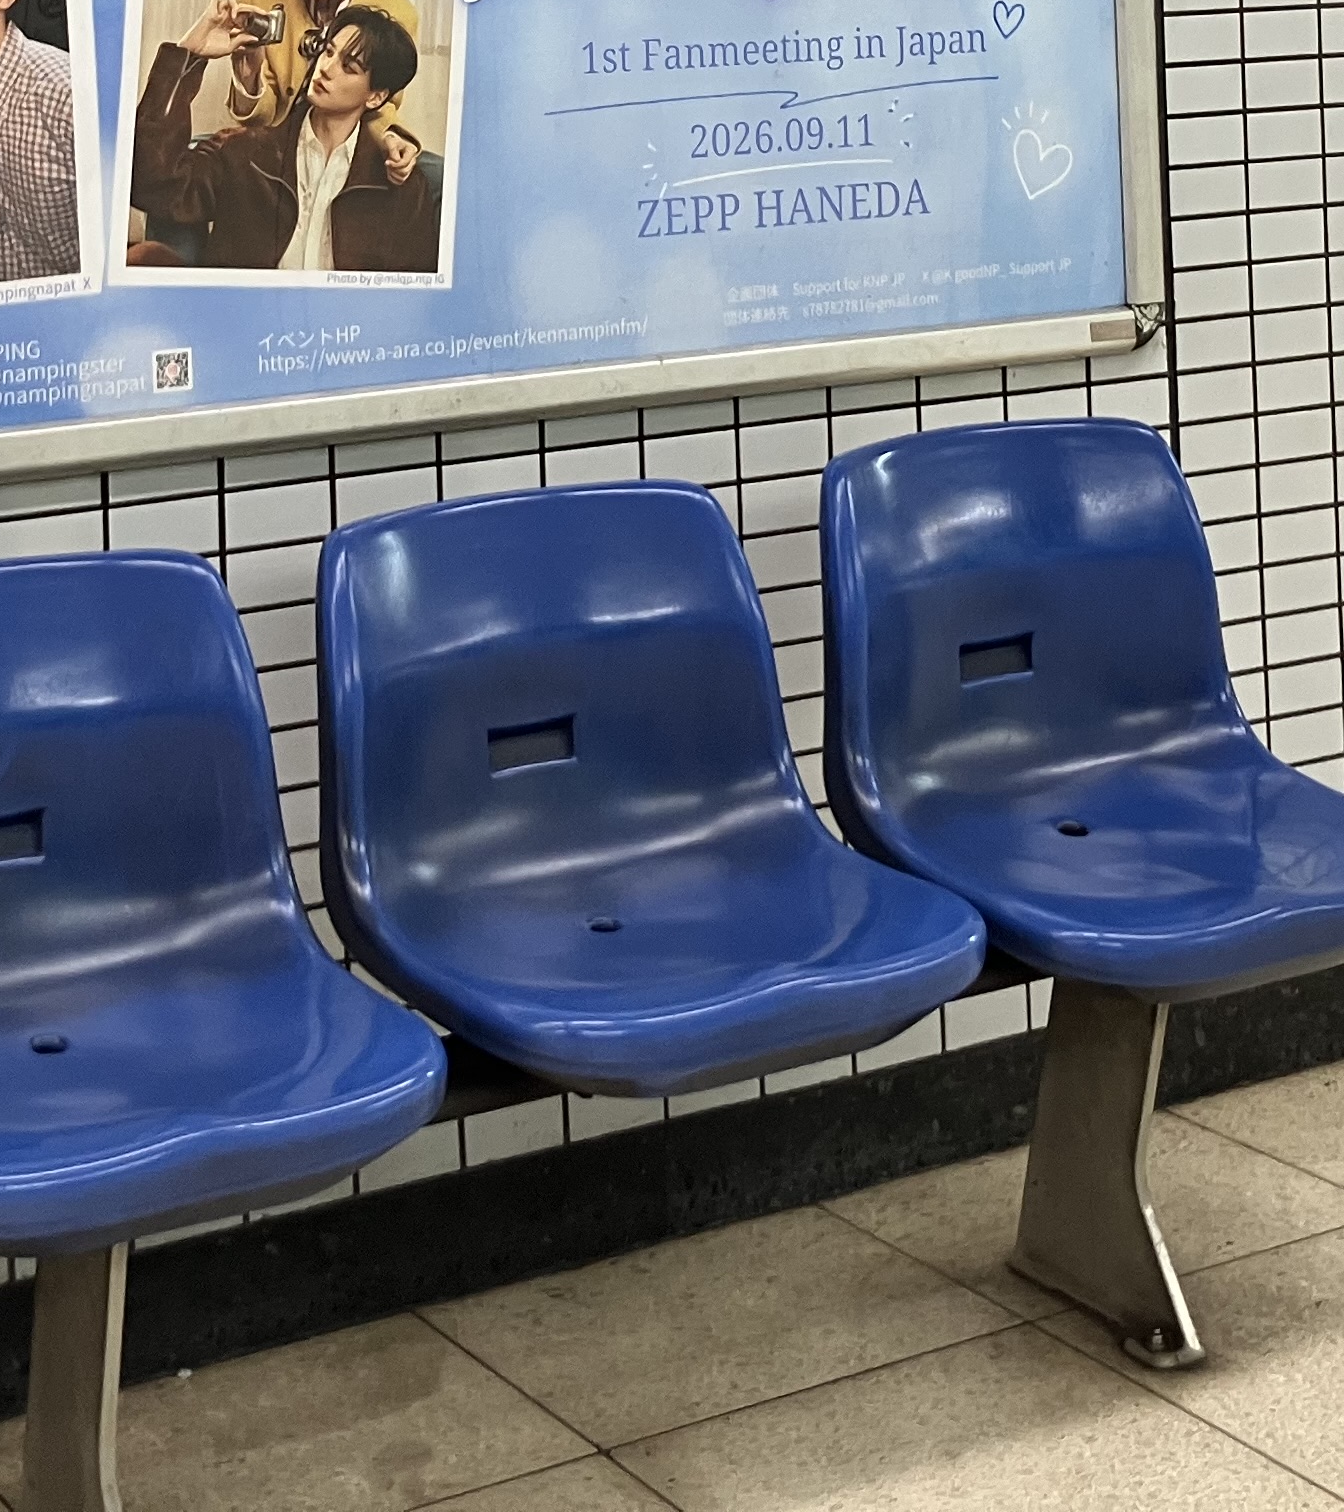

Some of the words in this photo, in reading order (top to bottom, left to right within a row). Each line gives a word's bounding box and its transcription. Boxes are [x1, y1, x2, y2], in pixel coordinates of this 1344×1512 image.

[582, 39, 631, 74] 1st
[642, 29, 845, 72] Fanmeeting
[855, 27, 886, 60] in
[896, 25, 987, 68] Japan
[690, 113, 875, 159] 2026.09.11
[637, 193, 741, 239] ZEPP
[755, 178, 931, 229] HANEDA
[83, 277, 92, 290] X
[327, 273, 358, 284] Photo
[360, 273, 373, 285] by
[793, 276, 841, 296] Support
[258, 325, 361, 351] イベントHP
